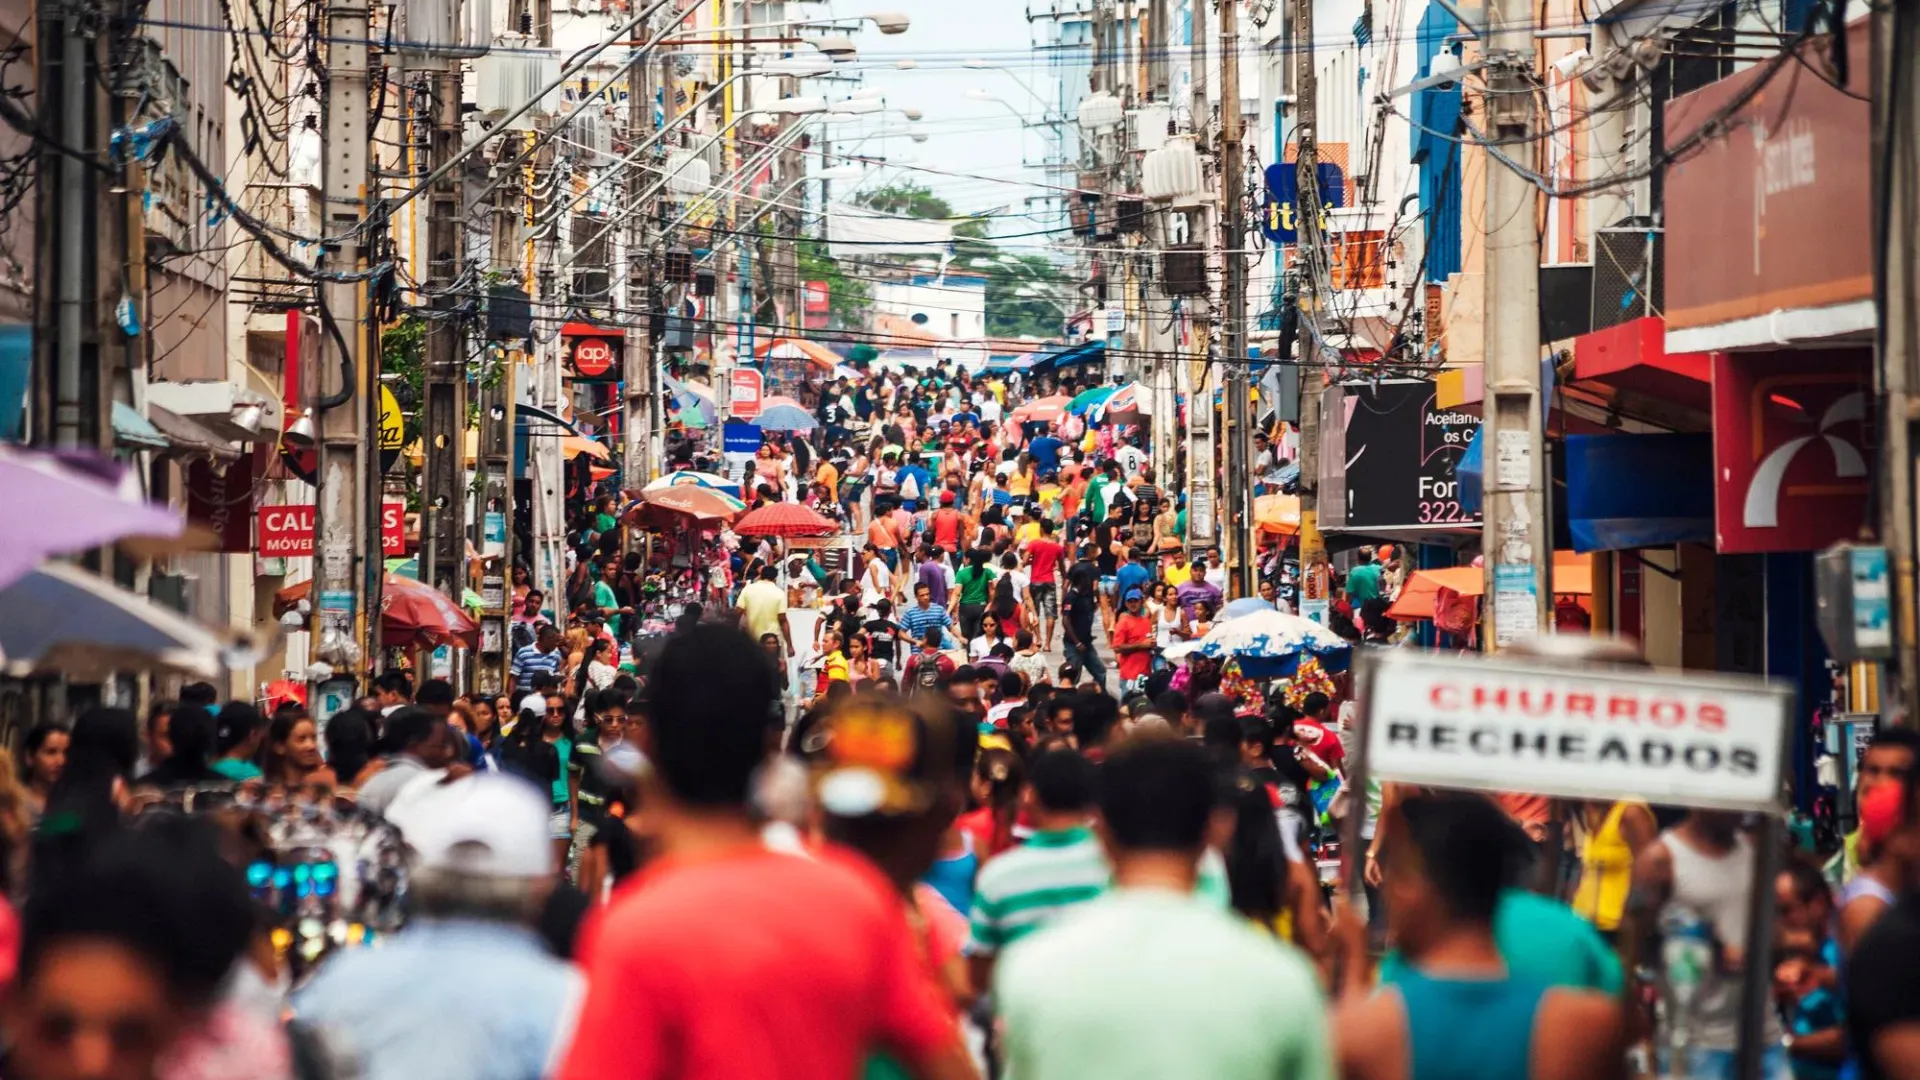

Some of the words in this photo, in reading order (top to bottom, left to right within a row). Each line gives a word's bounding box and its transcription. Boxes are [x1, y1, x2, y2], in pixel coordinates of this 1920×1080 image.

[1443, 432, 1460, 443] os
[1463, 428, 1475, 442] C
[1129, 455, 1137, 470] 8
[266, 536, 313, 550] MÓVEI
[1429, 683, 1728, 733] CHURROS
[1386, 722, 1761, 777] RECHEADOS
